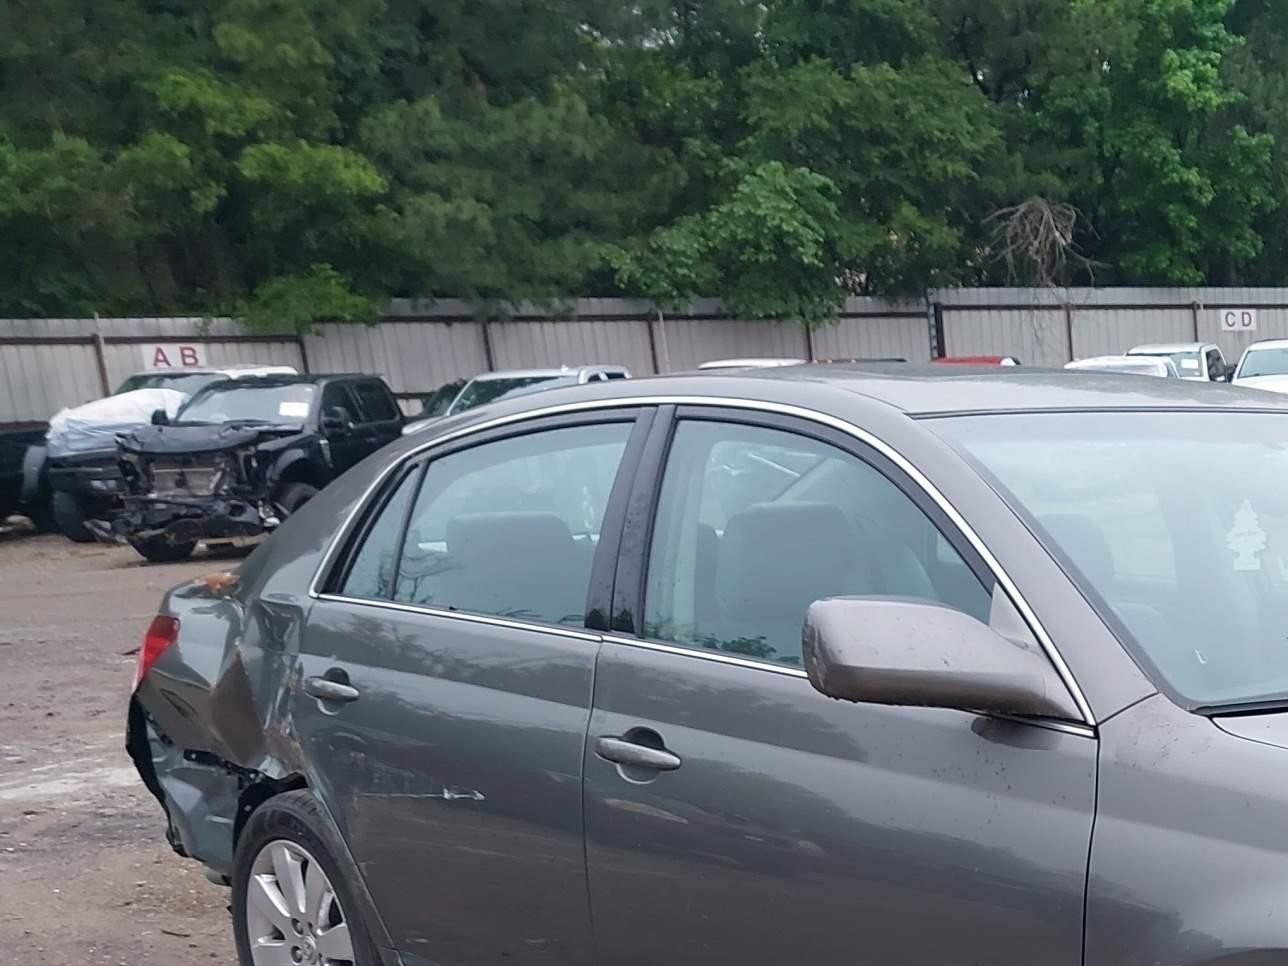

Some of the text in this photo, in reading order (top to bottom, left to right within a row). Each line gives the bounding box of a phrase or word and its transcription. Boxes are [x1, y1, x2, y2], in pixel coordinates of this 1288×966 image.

[1225, 311, 1252, 327] C D
[153, 346, 199, 366] A B
